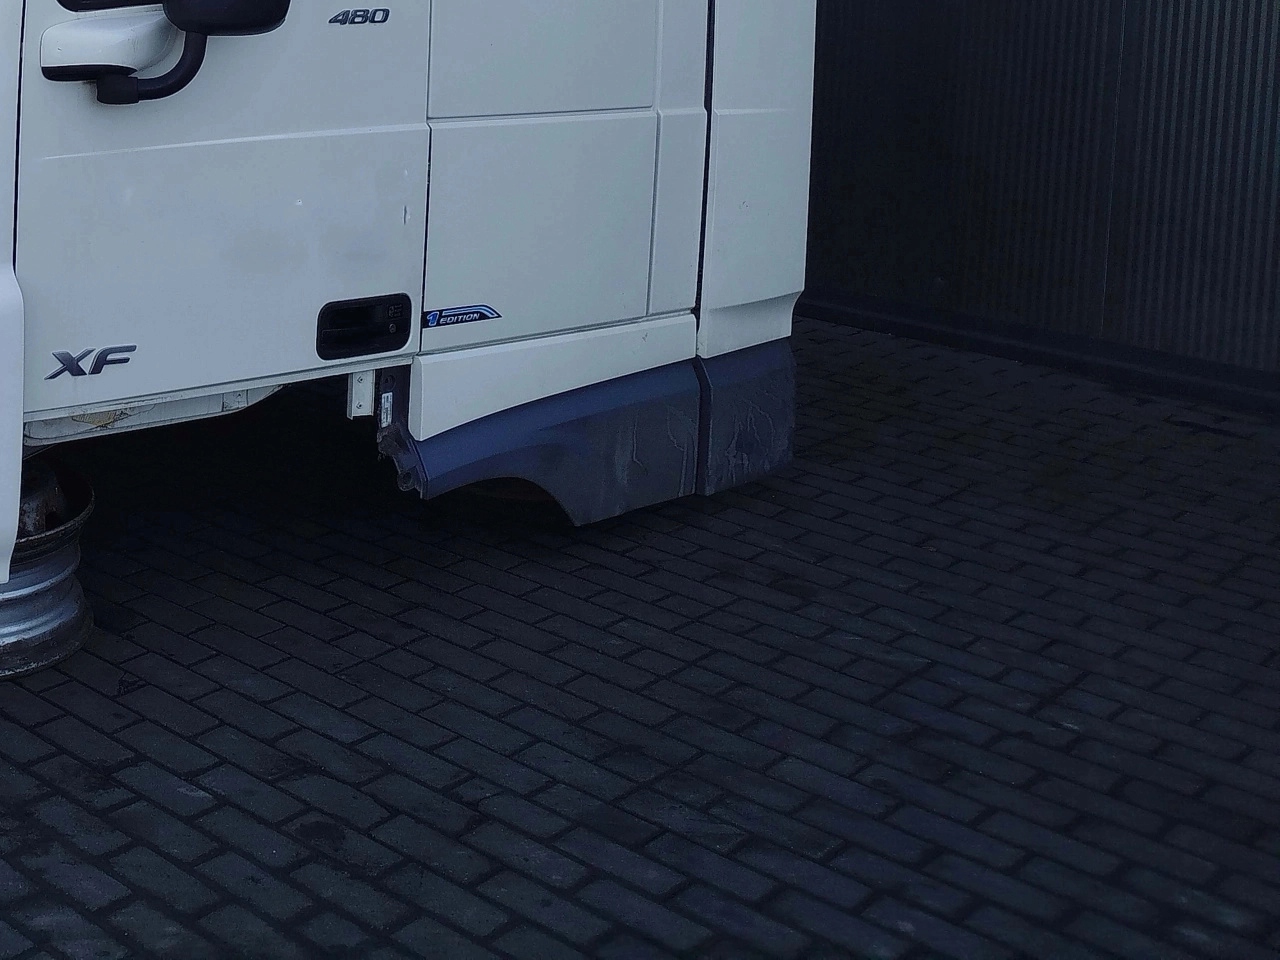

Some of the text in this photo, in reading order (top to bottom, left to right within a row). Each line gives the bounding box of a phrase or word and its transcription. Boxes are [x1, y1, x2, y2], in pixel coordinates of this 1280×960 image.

[328, 8, 390, 25] 480
[440, 313, 480, 324] EDITION
[44, 345, 137, 380] XF
